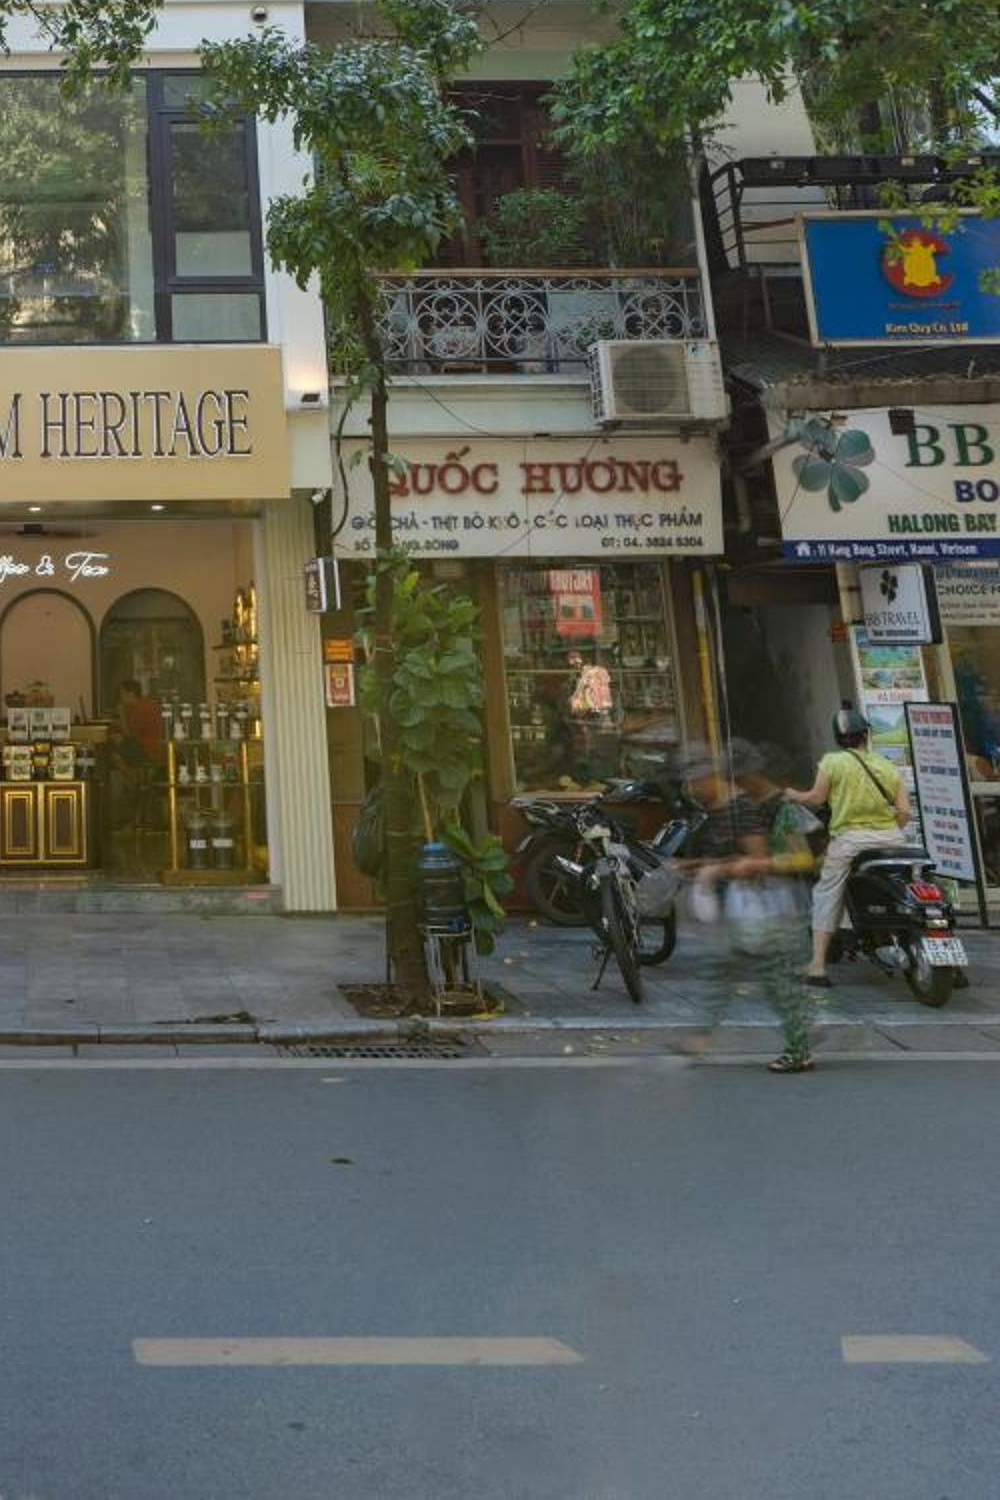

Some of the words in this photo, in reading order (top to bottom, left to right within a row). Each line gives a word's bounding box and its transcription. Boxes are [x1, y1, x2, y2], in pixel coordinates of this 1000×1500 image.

[40, 389, 252, 458] HERITAGE
[904, 423, 995, 468] BB
[520, 456, 684, 494] HƯƠNG
[888, 513, 960, 533] HALONG
[964, 513, 997, 533] BAY
[35, 555, 55, 575] &
